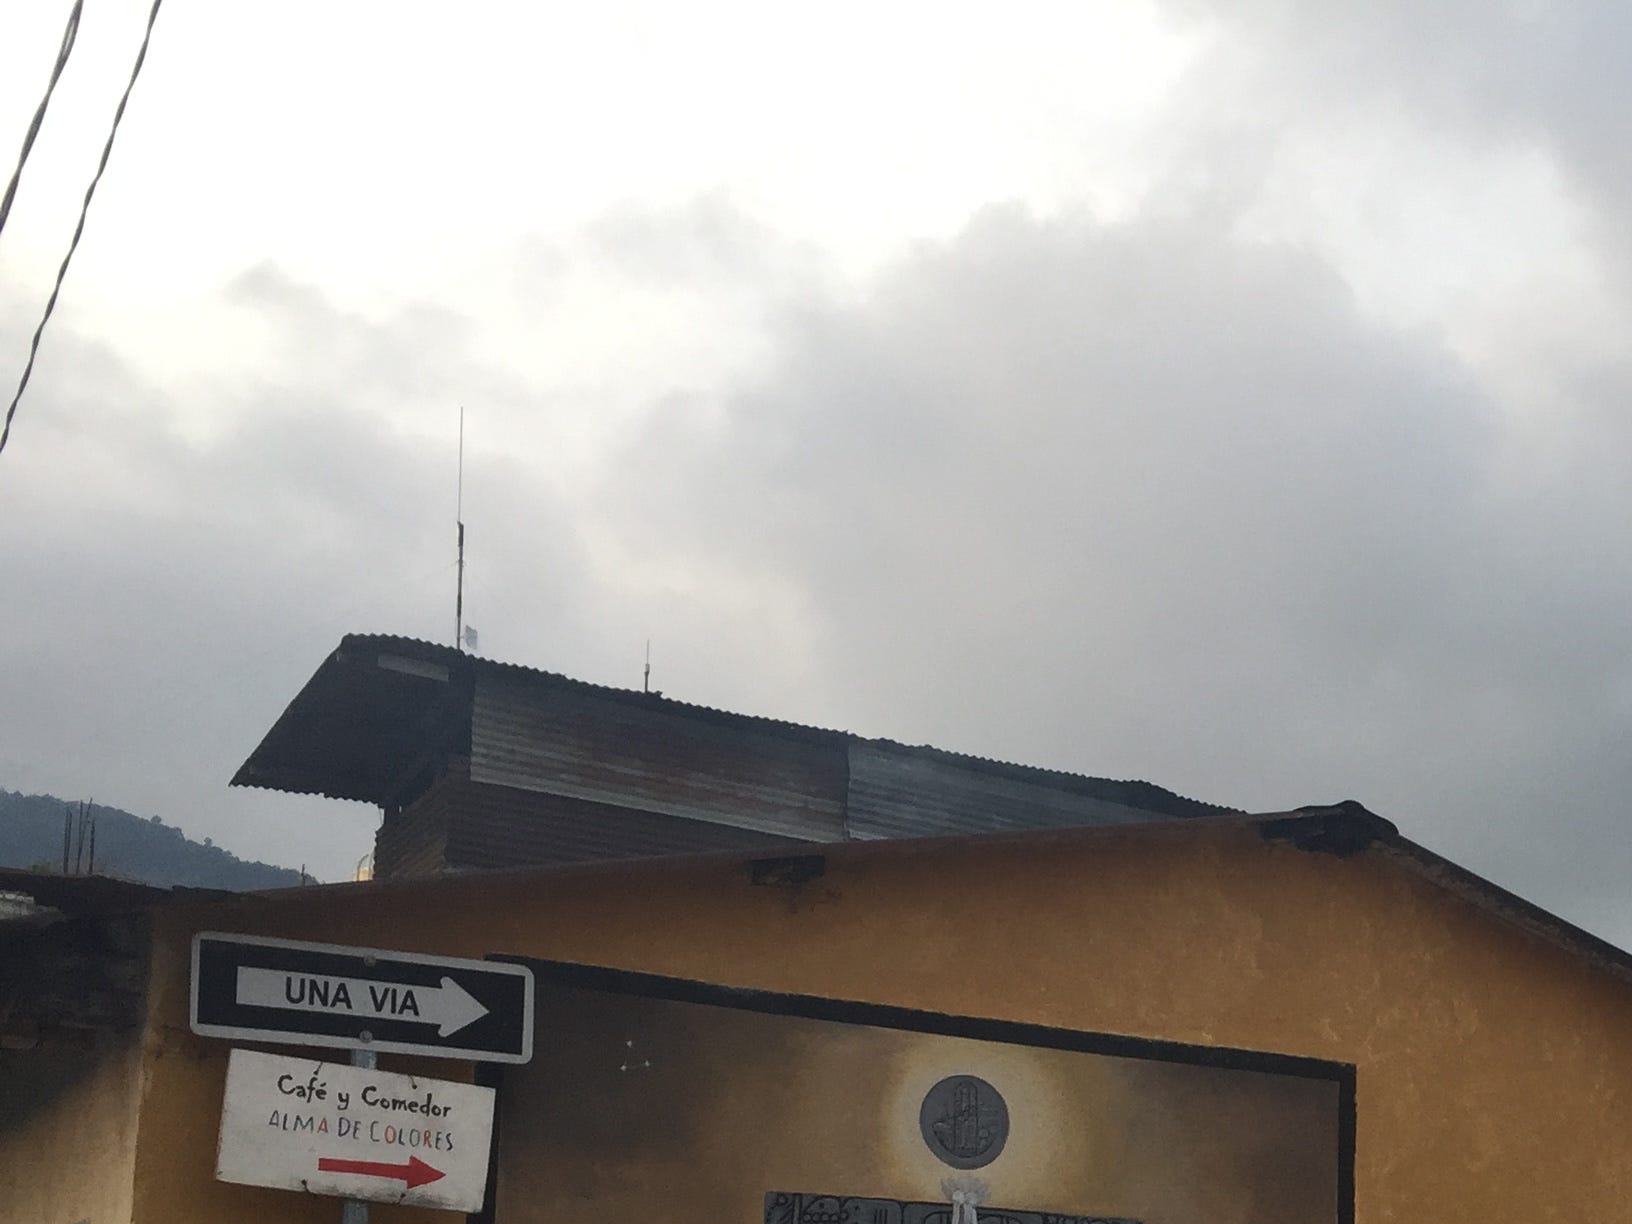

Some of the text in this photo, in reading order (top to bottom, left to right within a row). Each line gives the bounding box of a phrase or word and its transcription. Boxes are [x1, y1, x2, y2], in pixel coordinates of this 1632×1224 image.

[285, 976, 420, 1017] UNA VIA
[277, 1074, 452, 1119] Café y Comedor
[269, 1110, 454, 1151] ALMA DE COLORES
